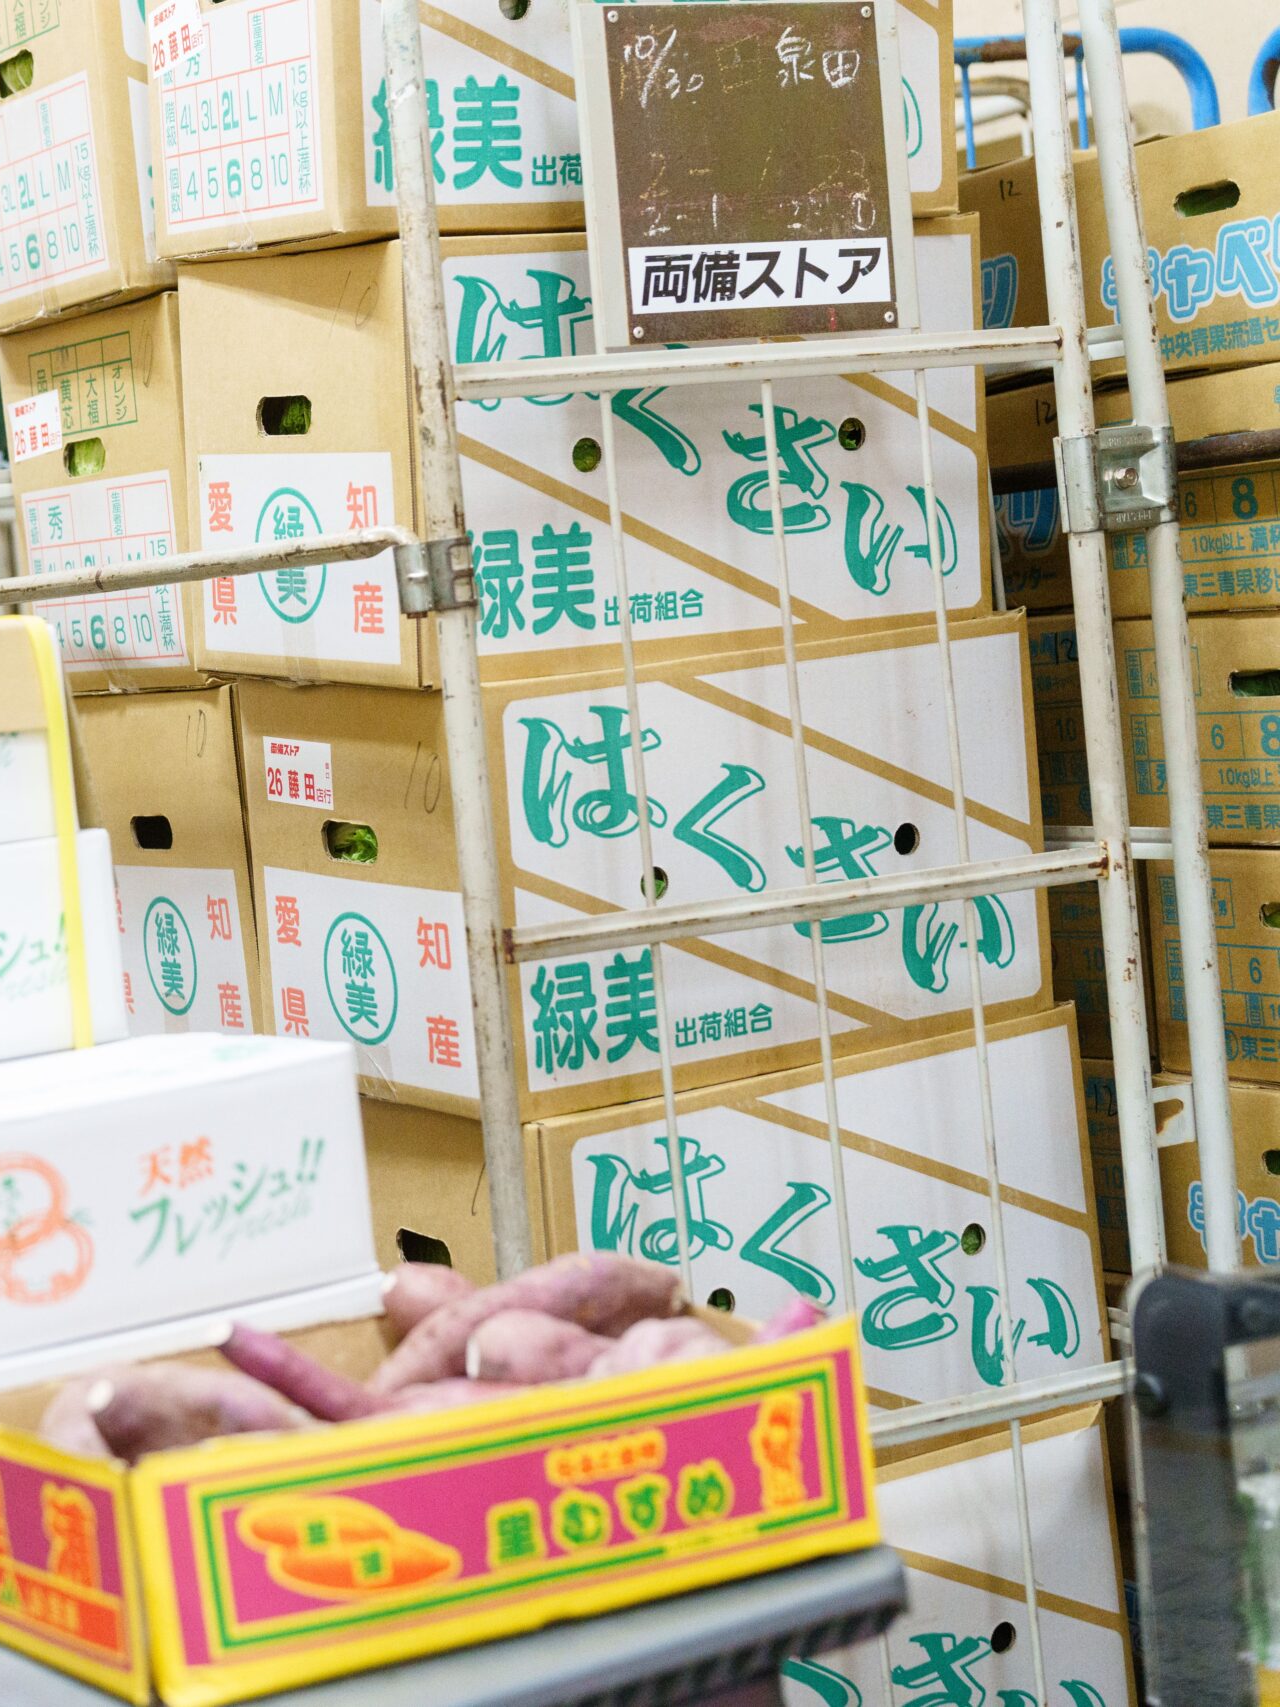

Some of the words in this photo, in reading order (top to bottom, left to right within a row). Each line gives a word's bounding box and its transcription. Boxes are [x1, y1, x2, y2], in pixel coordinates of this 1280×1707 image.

[153, 39, 166, 72] 26
[181, 104, 197, 136] 4L
[201, 98, 218, 132] 3L
[222, 89, 239, 131] 2L
[247, 90, 258, 121] L
[269, 82, 284, 116] M
[1, 183, 17, 213] 3L
[18, 172, 35, 210] 2L
[39, 171, 50, 199] L
[57, 160, 71, 193] M
[186, 171, 198, 201] 4
[207, 166, 219, 198] 5
[227, 158, 242, 199] 6
[251, 158, 263, 191] 8
[272, 153, 289, 188] 10
[998, 178, 1021, 200] 12
[10, 243, 21, 273] 5
[25, 233, 41, 270] 6
[47, 230, 59, 260] 8
[64, 223, 80, 253] 10
[641, 246, 882, 307] 両備ストア
[85, 374, 100, 425] 大福
[112, 364, 128, 421] オレンジ
[1035, 399, 1058, 426] 12
[48, 506, 63, 540] 秀
[208, 481, 234, 532] 愛
[346, 481, 378, 529] 知
[1184, 490, 1198, 518] 6
[1231, 477, 1259, 520] 8
[212, 576, 237, 626] 県
[353, 581, 385, 634] 産
[468, 520, 596, 639] 緑美
[603, 588, 705, 627] 出荷組合
[1183, 567, 1280, 597] 東三青果移
[72, 620, 84, 648] 5
[90, 615, 106, 650] 6
[114, 616, 127, 644] 8
[133, 614, 152, 643] 10
[1211, 723, 1225, 751] 6
[1260, 714, 1280, 757] 8
[267, 766, 283, 797] 26
[404, 740, 442, 814] 10
[517, 705, 1016, 995] はくさい
[206, 894, 233, 941] 知
[275, 895, 302, 948] 愛
[417, 916, 453, 971] 知
[154, 911, 186, 1001] 緑美
[340, 928, 380, 1029] 緑美
[1249, 957, 1263, 985] 6
[217, 981, 245, 1029] 産
[281, 986, 310, 1037] 県
[426, 1013, 462, 1068] 産
[531, 946, 660, 1075] 緑美
[674, 1002, 774, 1048] 出荷組合
[1094, 1084, 1118, 1118] 12
[586, 1136, 1081, 1387] はくさい
